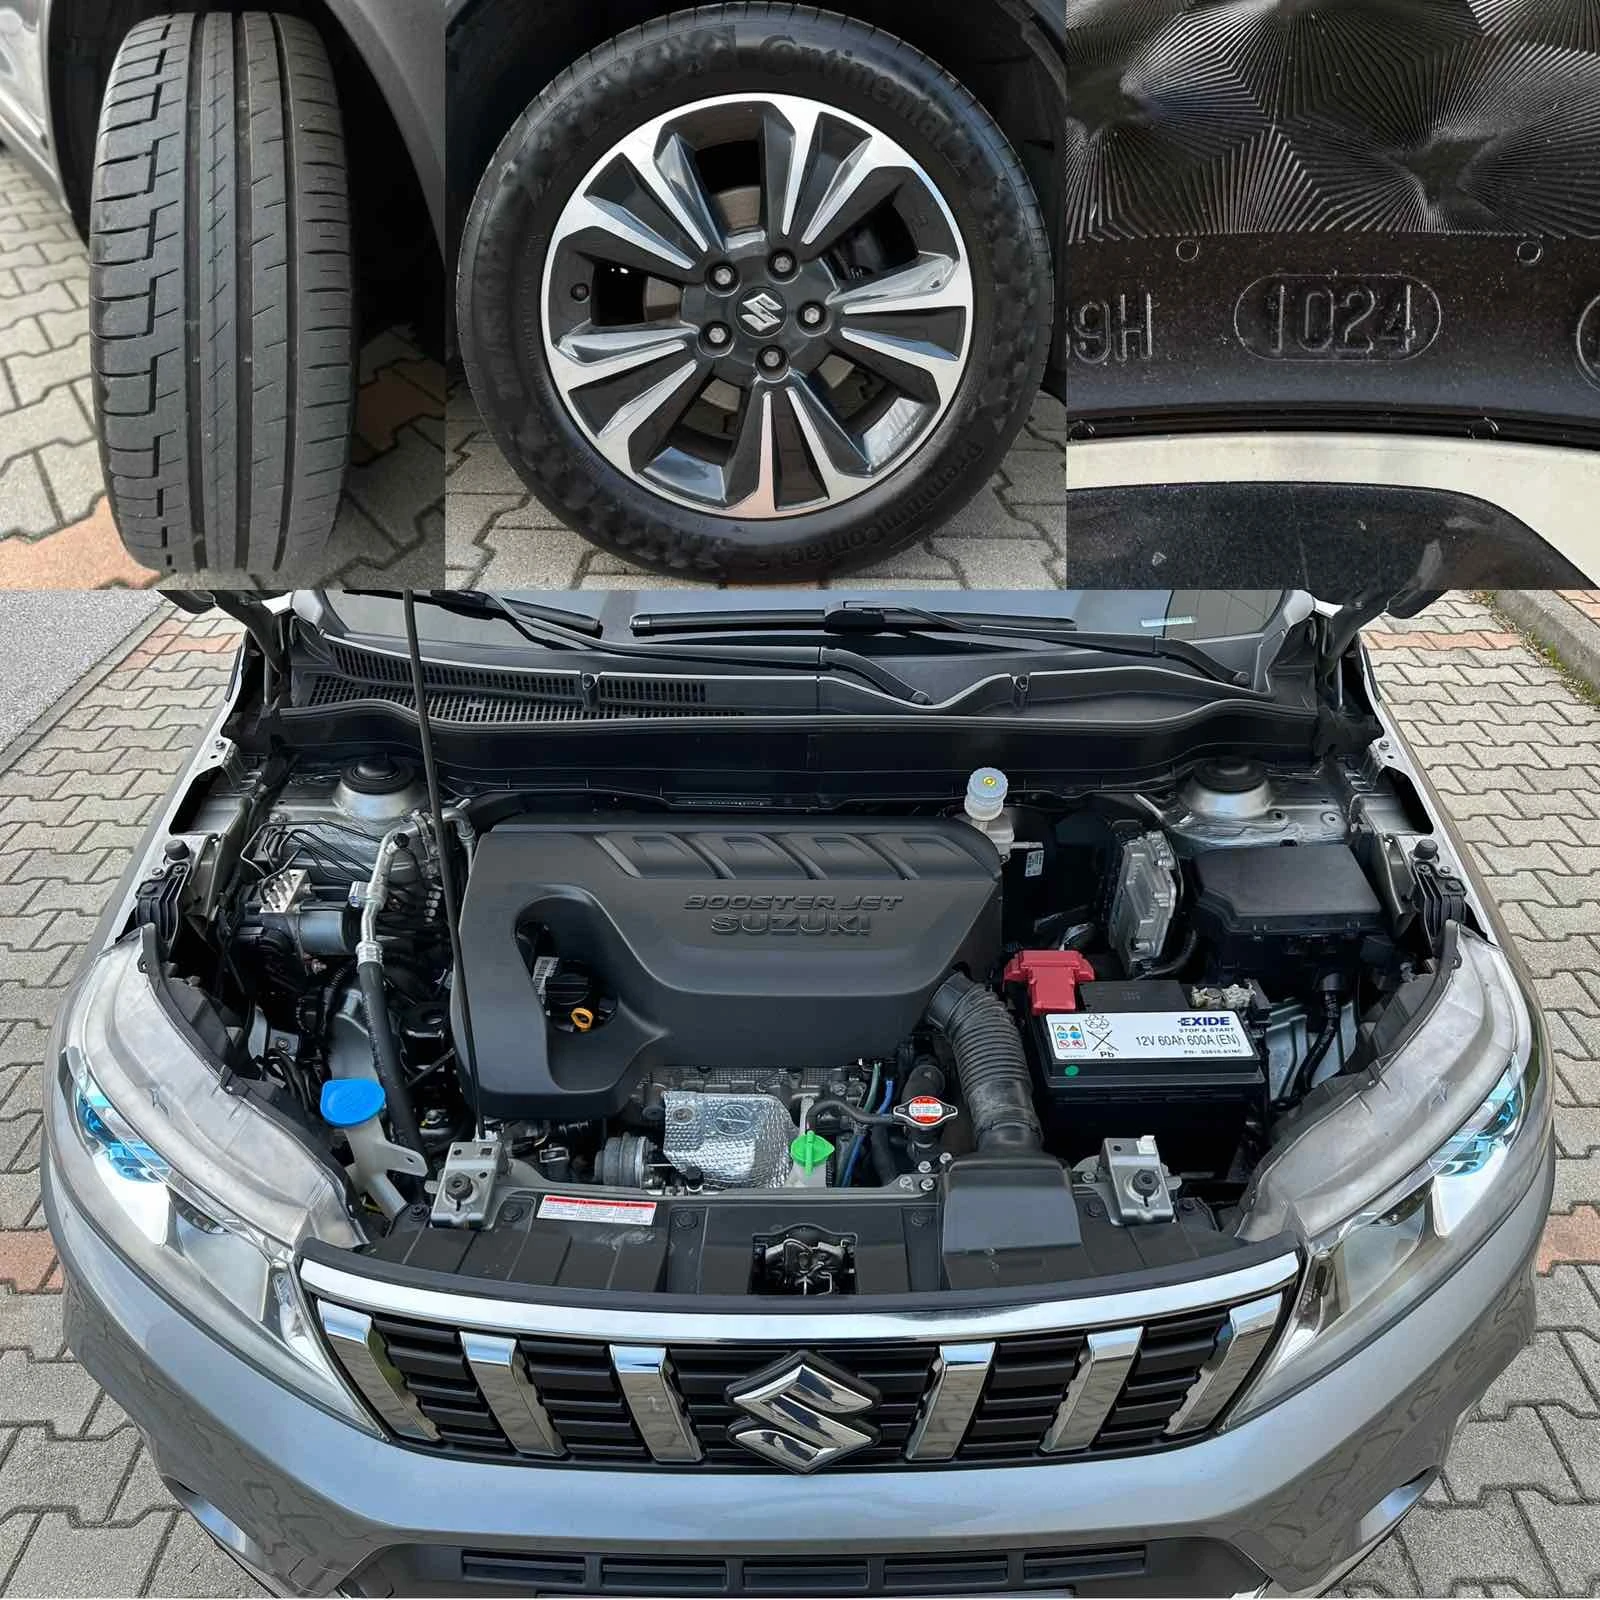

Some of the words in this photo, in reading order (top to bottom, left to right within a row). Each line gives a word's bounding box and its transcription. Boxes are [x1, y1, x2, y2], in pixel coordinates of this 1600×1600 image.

[1267, 283, 1417, 353] 1024
[711, 912, 871, 935] SUZUKI
[1178, 1016, 1230, 1026] EXIDE
[1136, 1035, 1155, 1046] 12V
[1158, 1035, 1185, 1046] 60Ah
[1187, 1034, 1215, 1046] 600A
